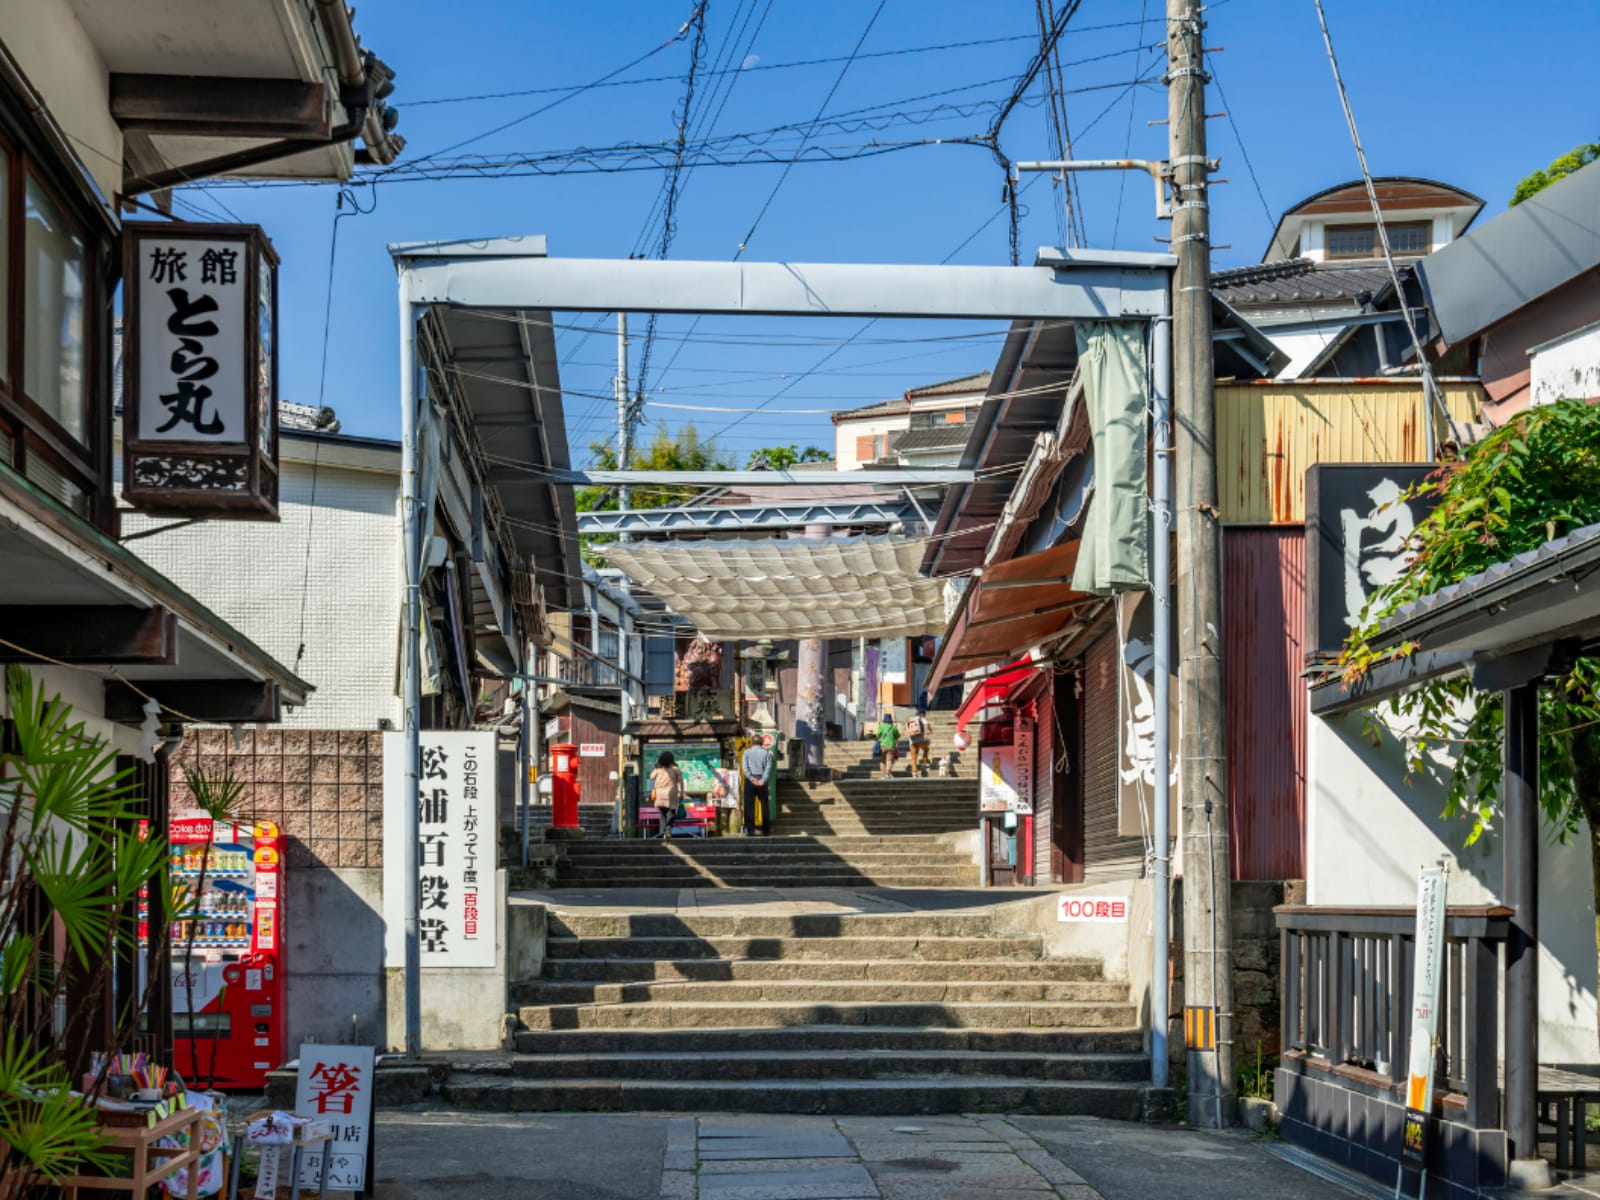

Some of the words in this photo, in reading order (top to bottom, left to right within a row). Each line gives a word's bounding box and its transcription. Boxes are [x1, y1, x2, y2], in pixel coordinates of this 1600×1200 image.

[150, 247, 239, 285] 旅館
[155, 287, 225, 435] とら丸
[463, 746, 478, 799] この石段
[1061, 901, 1125, 918] 100段目
[307, 1061, 361, 1114] 箸
